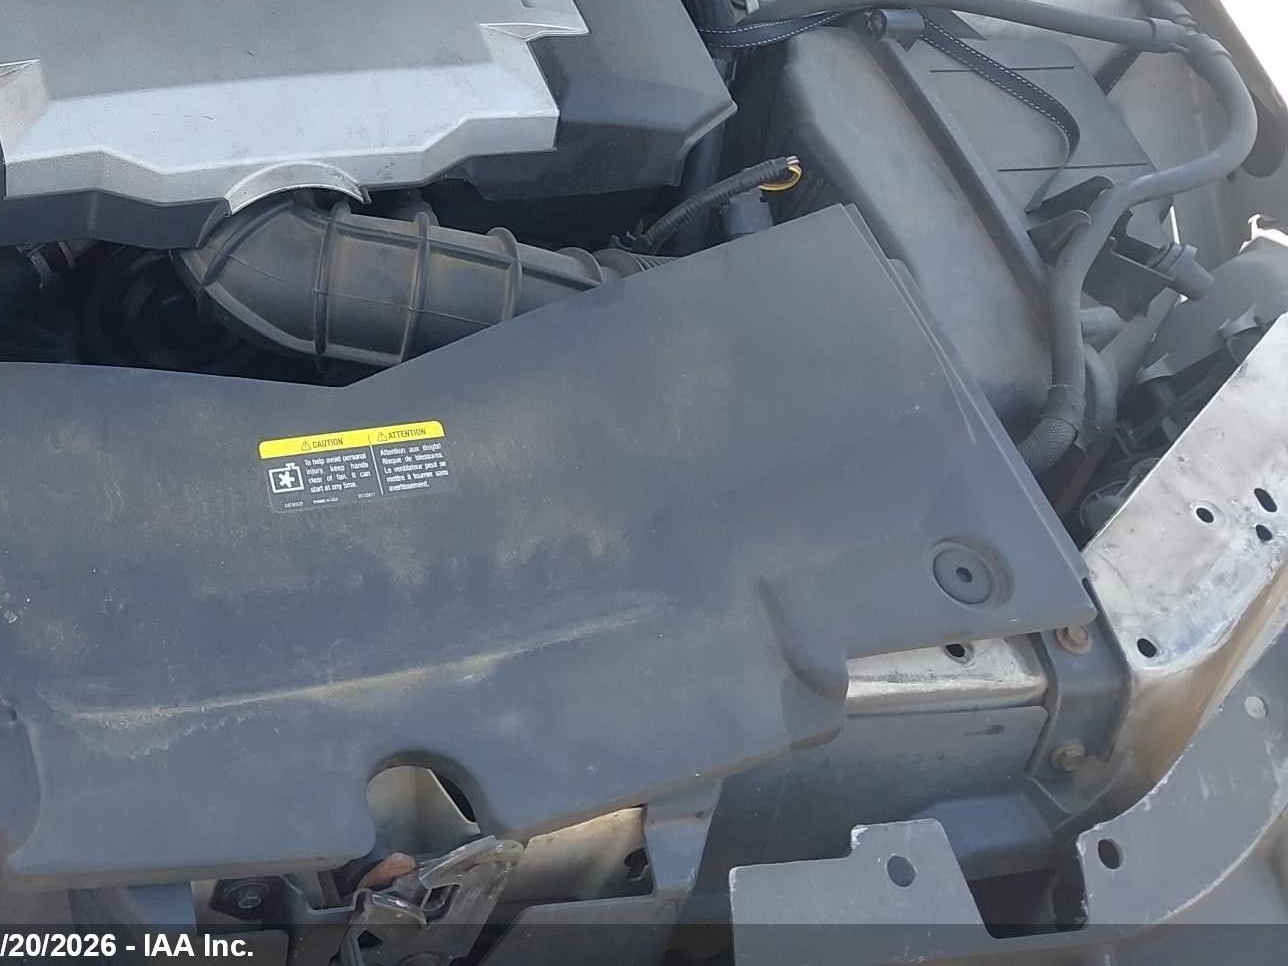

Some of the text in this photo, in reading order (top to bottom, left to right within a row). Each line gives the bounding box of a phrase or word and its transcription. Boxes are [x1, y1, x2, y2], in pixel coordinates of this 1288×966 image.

[388, 428, 426, 440] ATTENTION
[312, 438, 343, 449] CAUTION
[380, 447, 406, 456] Attention
[312, 458, 324, 466] help
[326, 456, 341, 464] avoid
[342, 452, 367, 463] personal
[381, 457, 402, 466] Risque
[329, 465, 345, 473] keep
[350, 461, 369, 470] hands
[384, 466, 392, 474] Le
[393, 463, 422, 473] ventilateur
[424, 462, 438, 470] peut
[308, 476, 323, 484] clear
[386, 475, 405, 483] mettre
[310, 485, 324, 493] start
[331, 483, 342, 492] any
